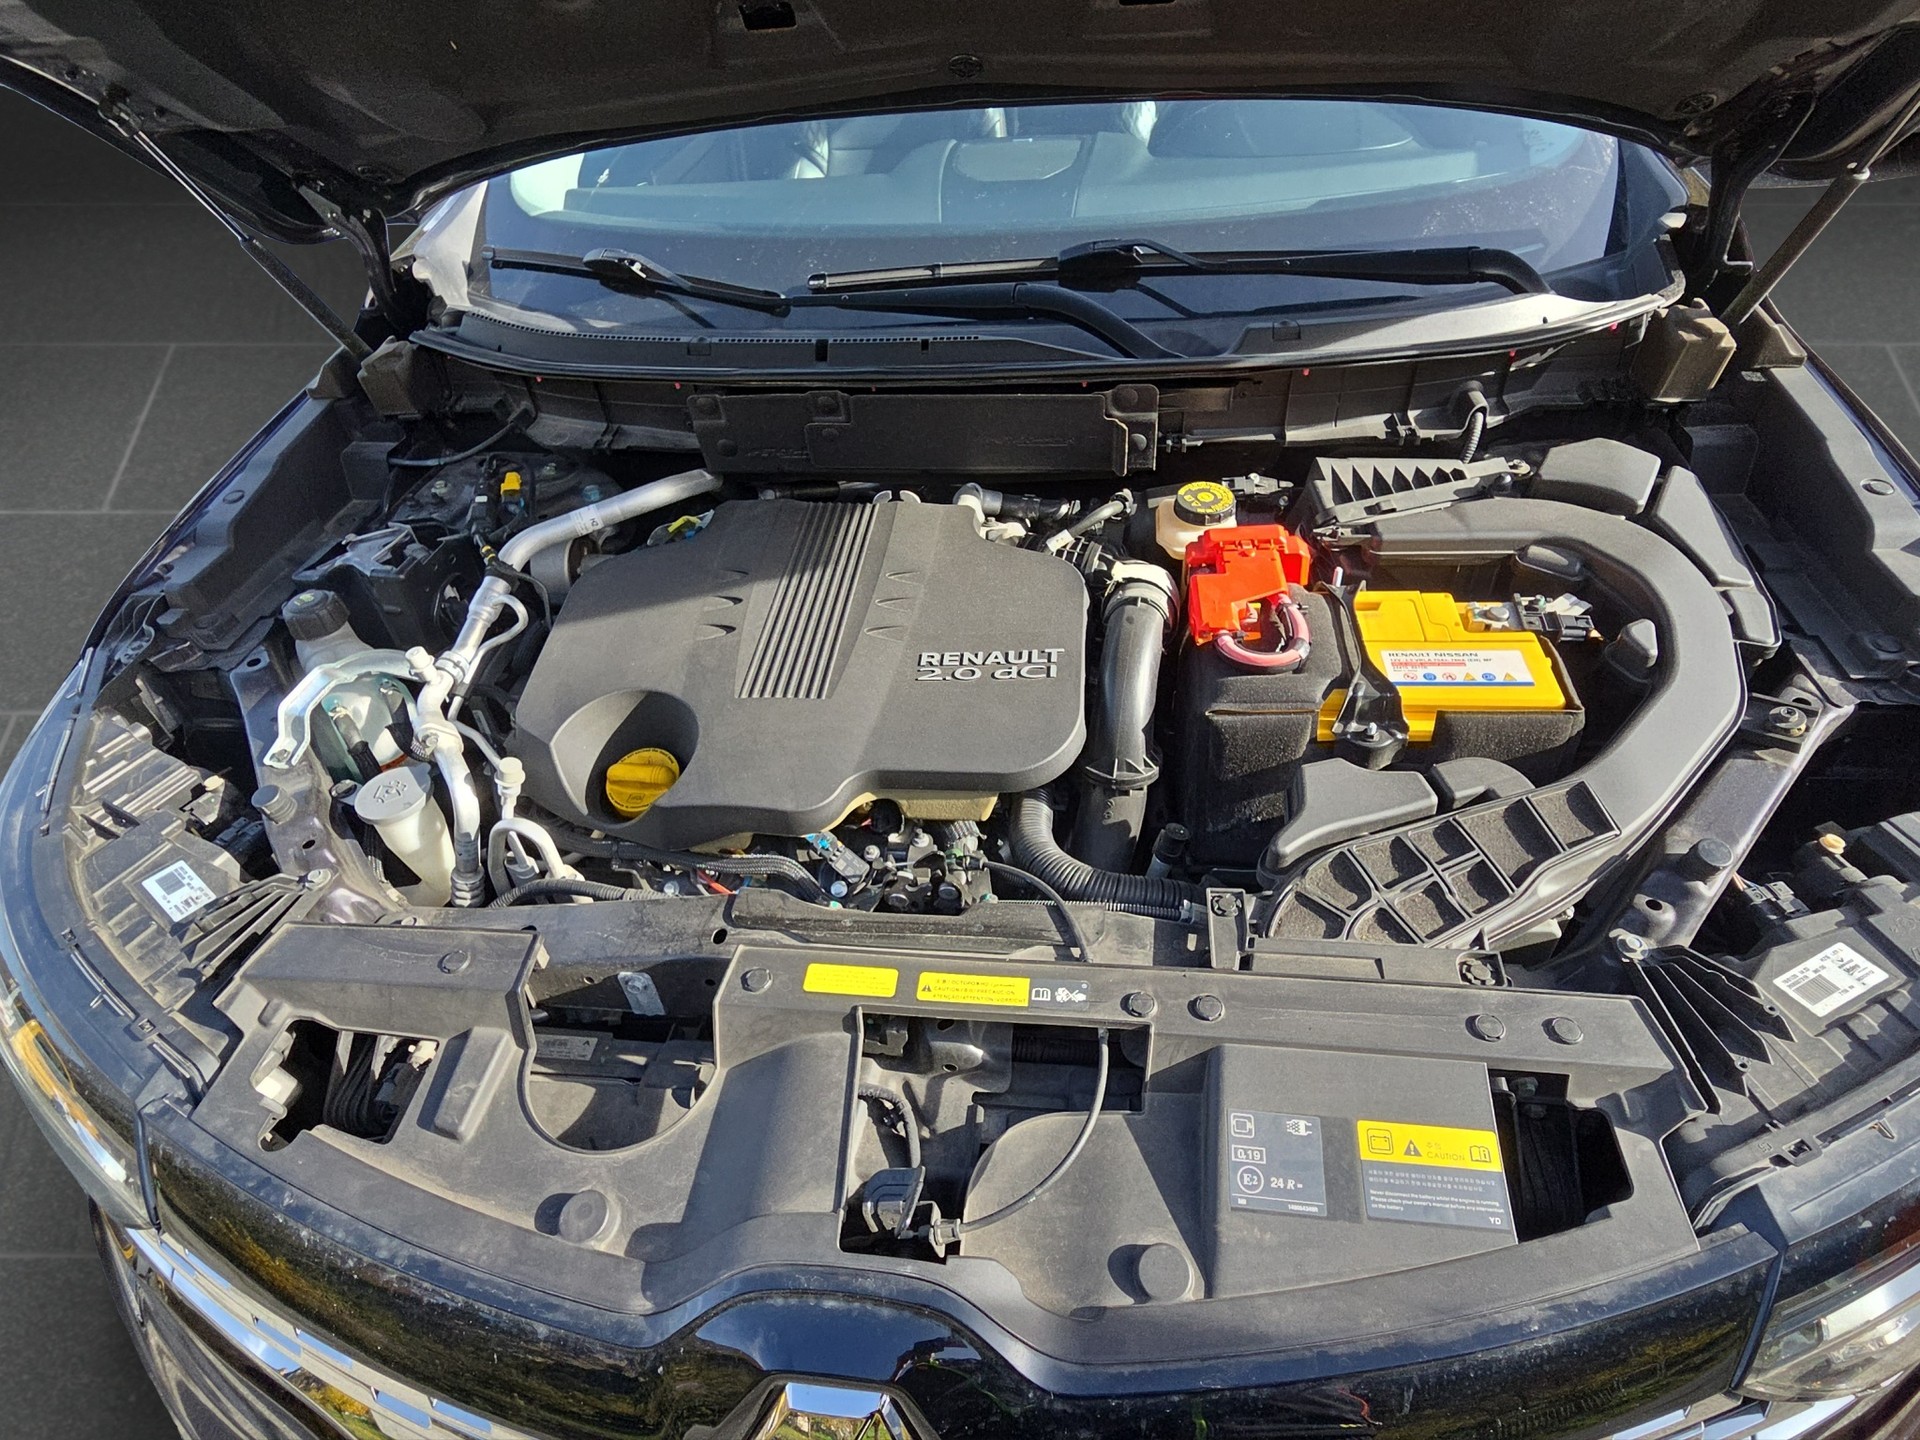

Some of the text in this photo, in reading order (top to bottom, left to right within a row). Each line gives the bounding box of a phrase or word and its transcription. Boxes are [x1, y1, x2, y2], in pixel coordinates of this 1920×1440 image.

[919, 648, 1065, 666] RENAULT
[916, 667, 982, 681] 2.0
[1426, 1151, 1465, 1161] CAUTION
[1270, 1177, 1285, 1189] 24
[1489, 1216, 1502, 1225] YD
